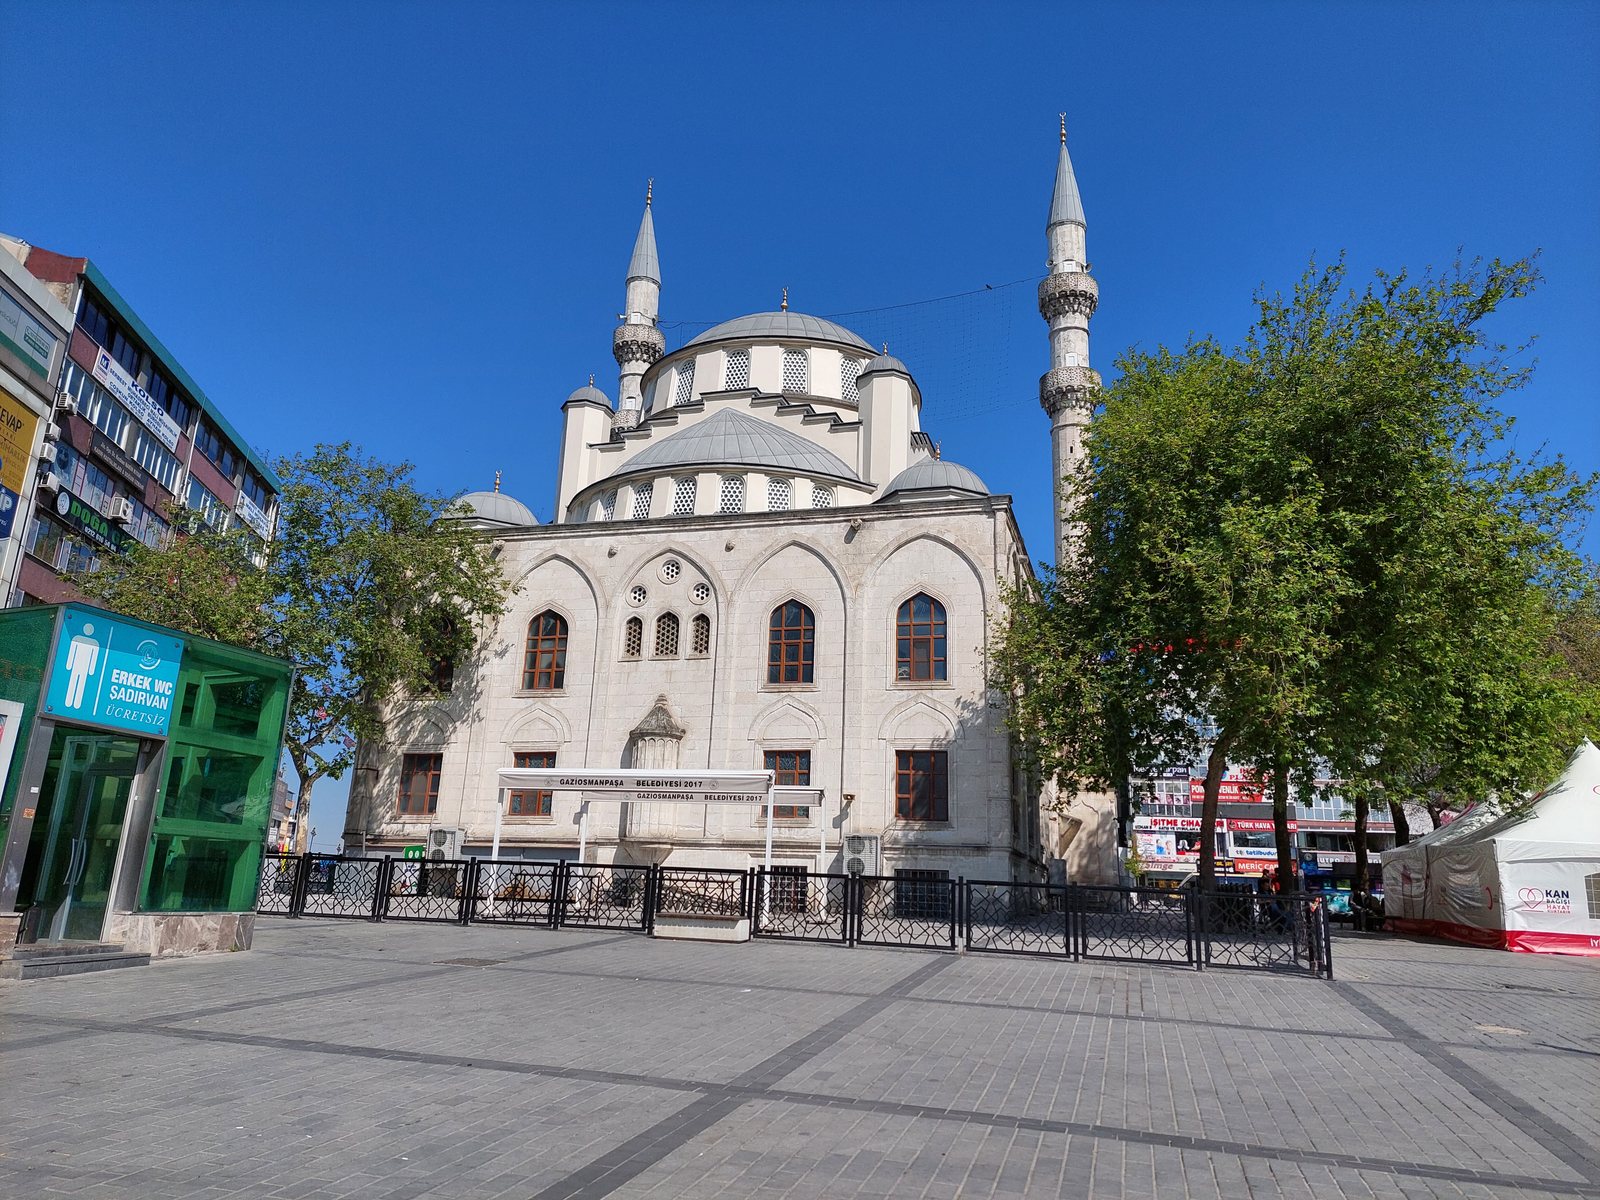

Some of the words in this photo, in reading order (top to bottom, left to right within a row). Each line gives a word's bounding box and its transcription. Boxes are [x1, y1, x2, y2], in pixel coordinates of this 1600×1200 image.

[130, 379, 164, 417] KOLSO
[128, 399, 144, 417] KOLSO
[0, 408, 22, 433] EVAP
[111, 668, 152, 690] ERKEK
[154, 679, 173, 695] WC
[109, 685, 168, 710] ŞADIRVAN
[106, 703, 165, 726] ÜCRETSİZ
[560, 777, 624, 787] GAZİOSMANPAŞA
[636, 779, 682, 788] BELEDİYESİ
[1150, 818, 1178, 828] İŞİTME
[1237, 821, 1254, 829] TÜRK
[1238, 861, 1263, 871] MERİÇ
[1545, 889, 1569, 898] KAN
